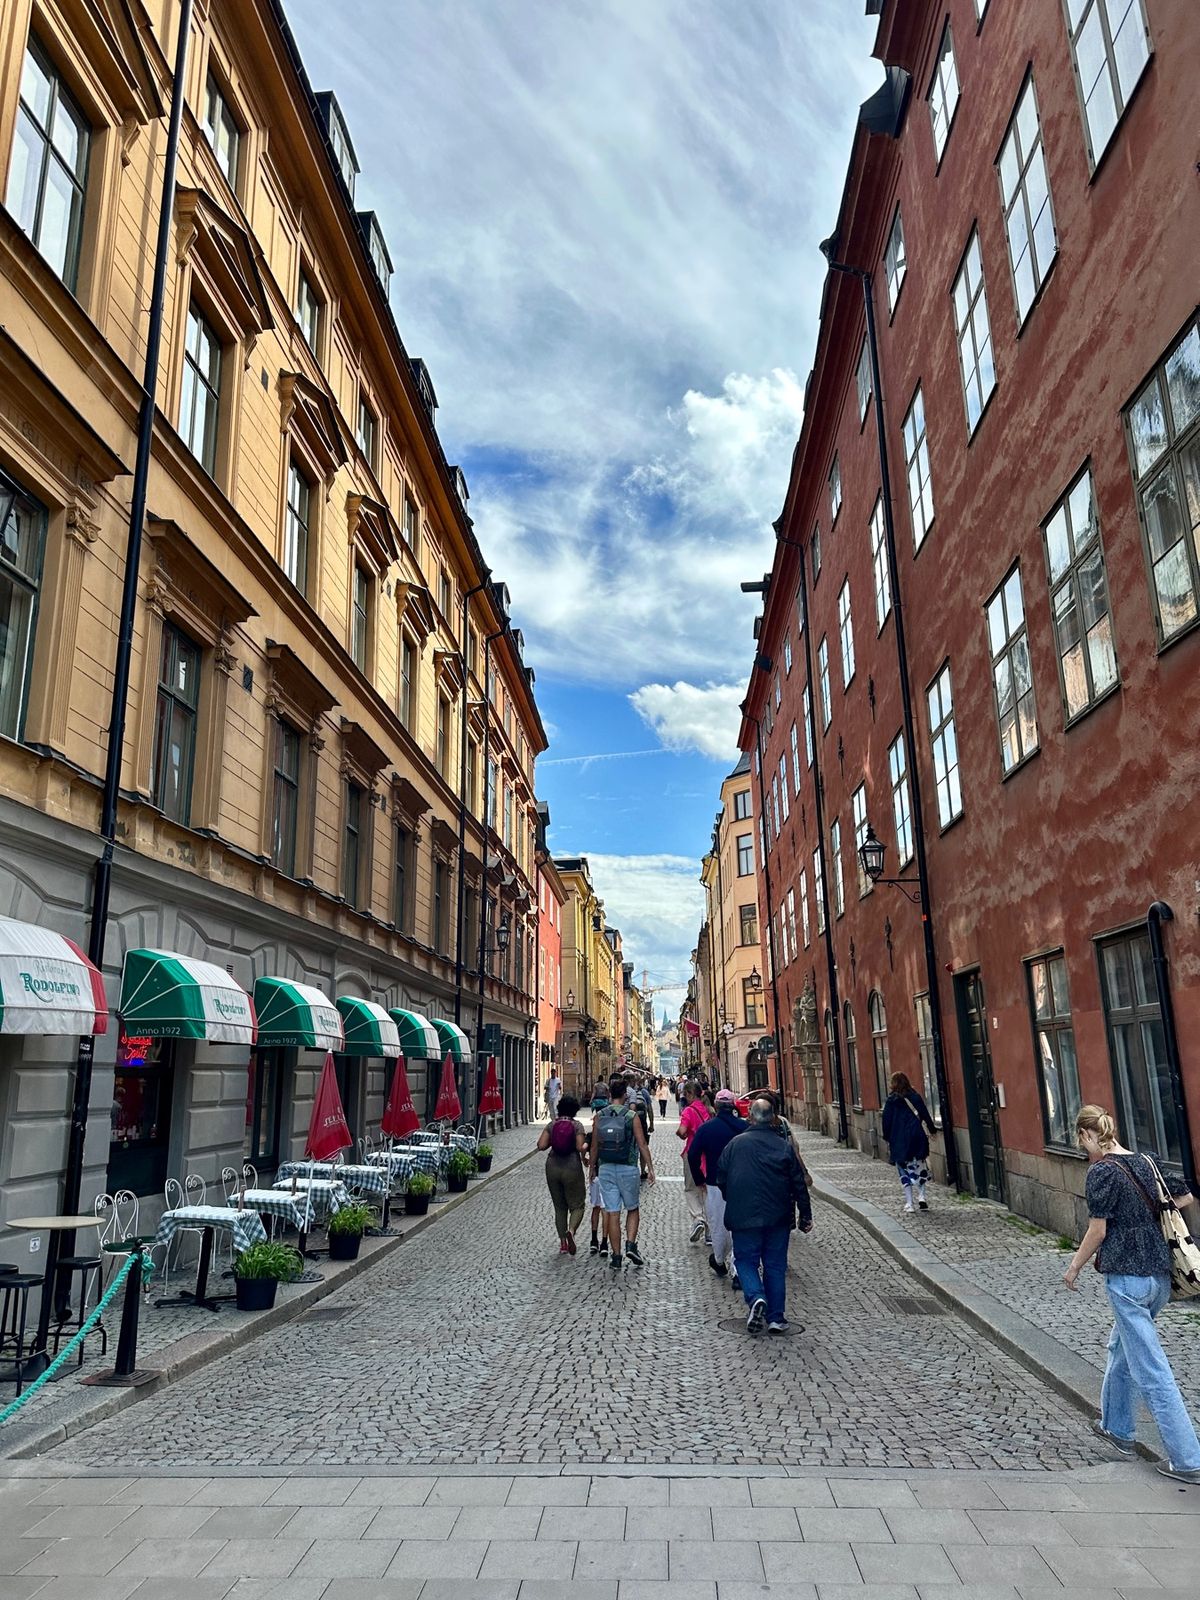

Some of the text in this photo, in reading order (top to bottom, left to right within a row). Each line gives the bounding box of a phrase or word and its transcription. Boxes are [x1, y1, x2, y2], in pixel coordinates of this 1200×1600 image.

[135, 1026, 181, 1035] Anno 1972
[282, 1037, 297, 1045] 1972
